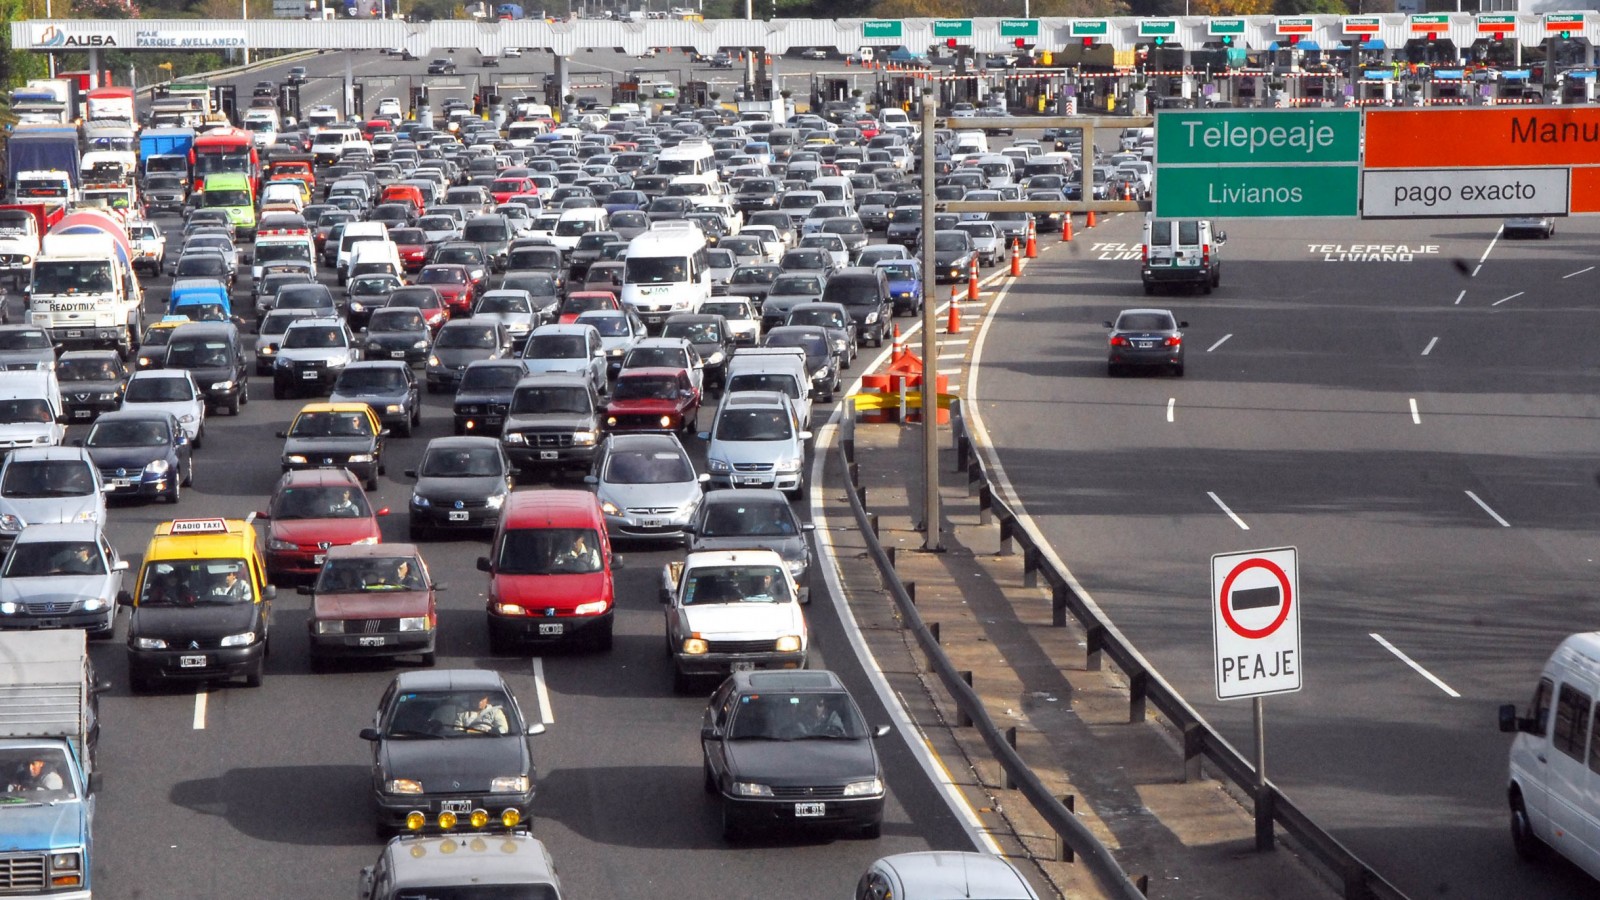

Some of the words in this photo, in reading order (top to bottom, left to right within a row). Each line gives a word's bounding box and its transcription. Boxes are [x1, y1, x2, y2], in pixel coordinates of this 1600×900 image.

[65, 35, 117, 46] AUSA
[136, 38, 177, 46] PARQUE
[180, 38, 246, 46] AVELLANEDA
[1181, 119, 1335, 153] Telepeaje
[1209, 183, 1303, 203] Livianos
[1394, 185, 1452, 206] pago
[1460, 181, 1536, 201] exacto
[1307, 244, 1440, 254] TELEPEAJE
[1324, 253, 1414, 262] LIVIANO
[49, 302, 96, 311] READYMIX
[1222, 650, 1295, 683] PEAJE
